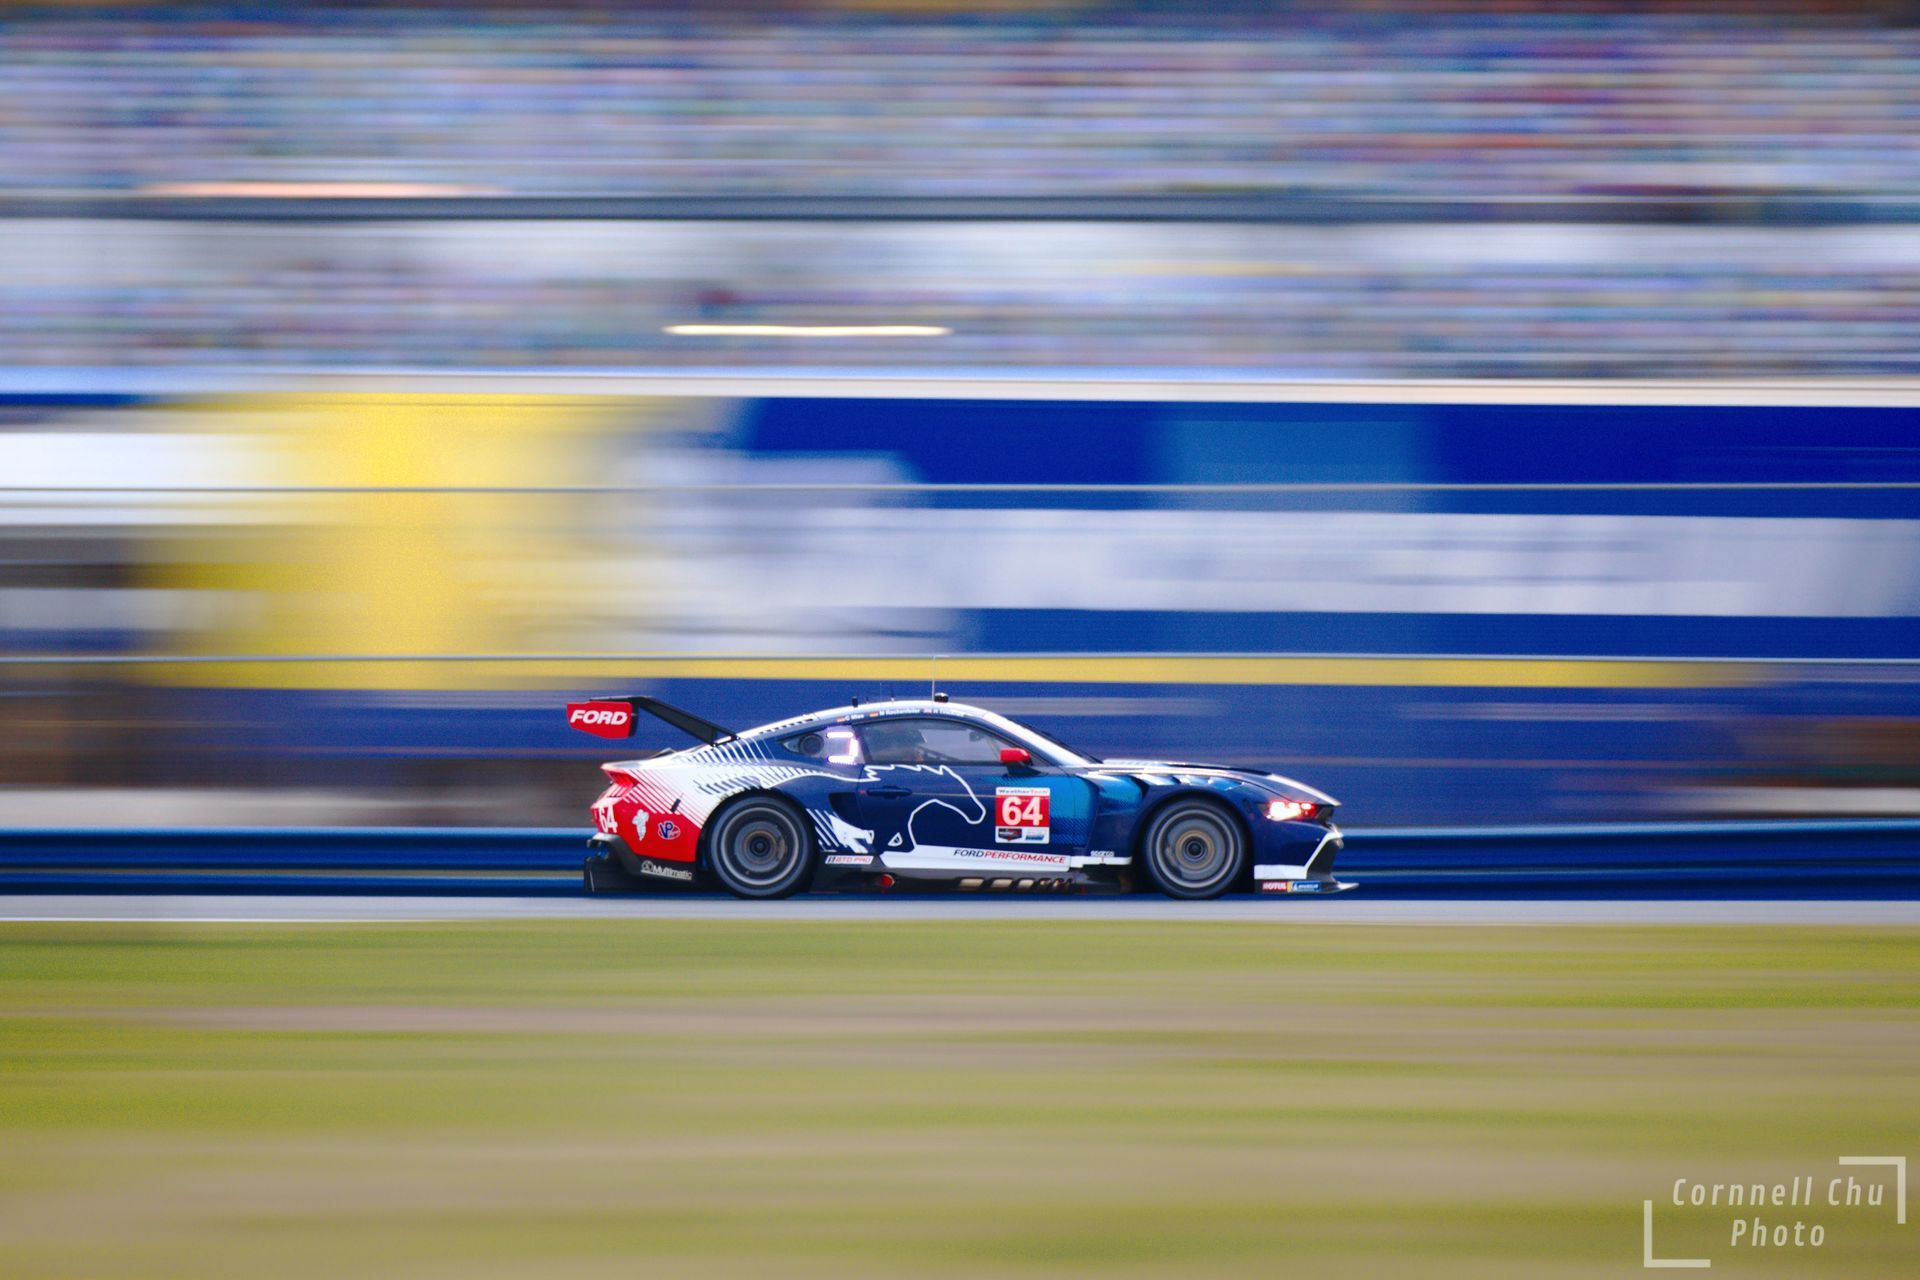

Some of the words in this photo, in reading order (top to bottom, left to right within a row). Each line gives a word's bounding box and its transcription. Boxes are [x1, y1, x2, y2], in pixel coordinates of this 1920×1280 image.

[570, 709, 628, 725] FORD
[598, 805, 618, 833] 64
[1002, 795, 1043, 826] 64
